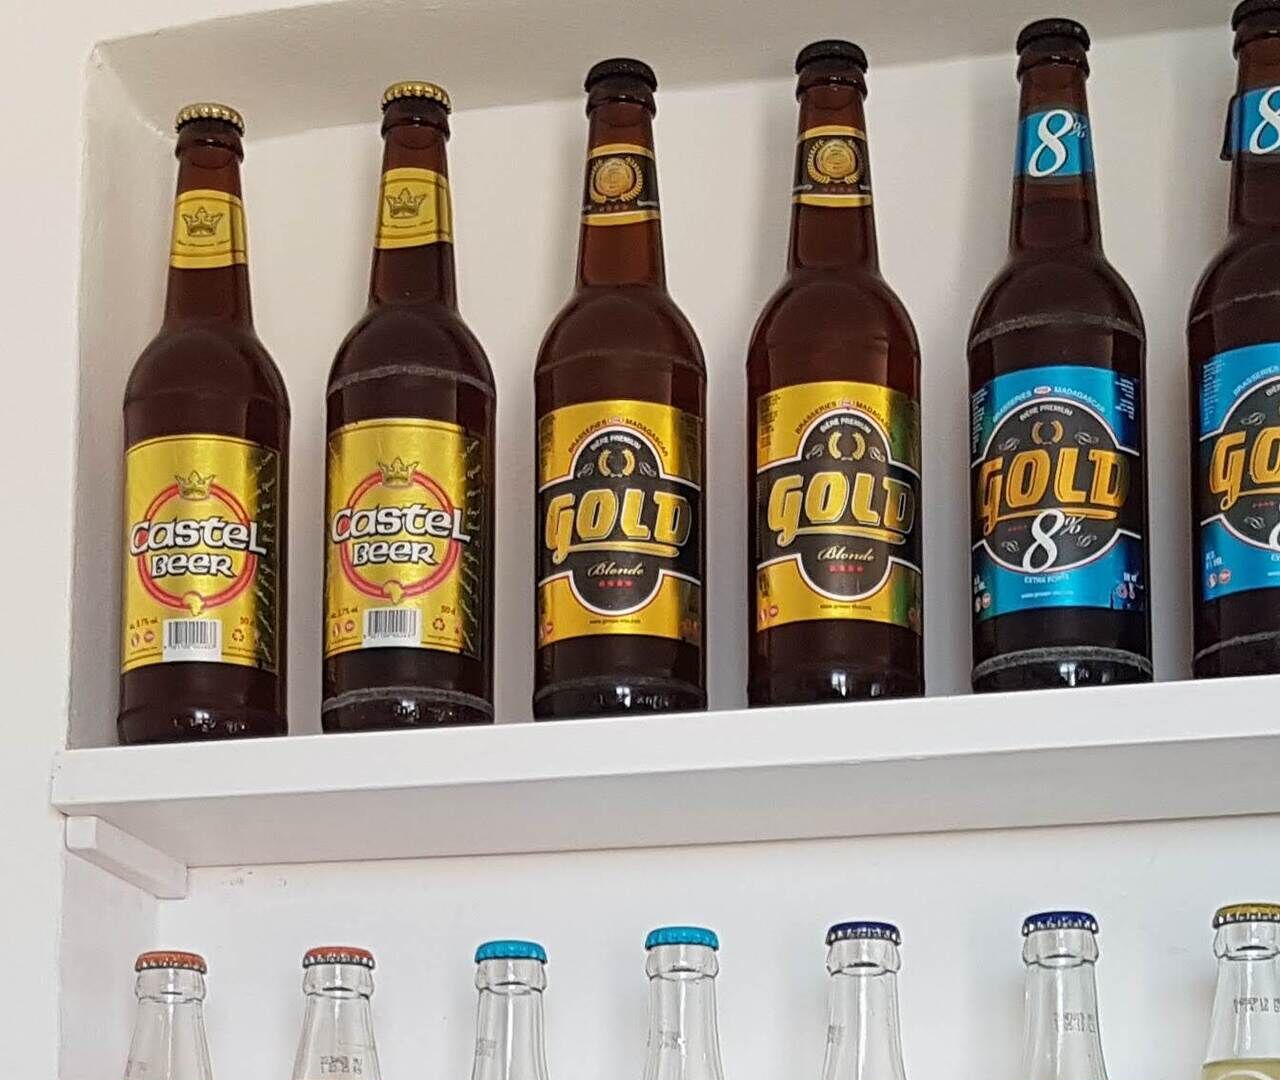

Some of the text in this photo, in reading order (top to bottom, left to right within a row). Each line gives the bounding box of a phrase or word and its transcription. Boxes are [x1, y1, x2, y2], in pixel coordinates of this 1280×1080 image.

[1028, 108, 1089, 178] 8%
[1039, 404, 1074, 417] PREMIUM
[1054, 386, 1106, 413] MADAGASCAR
[767, 471, 916, 547] GOLD
[980, 447, 1131, 537] GOLD
[130, 516, 267, 555] Castel
[331, 503, 471, 543] Castel
[545, 488, 693, 565] GOLD
